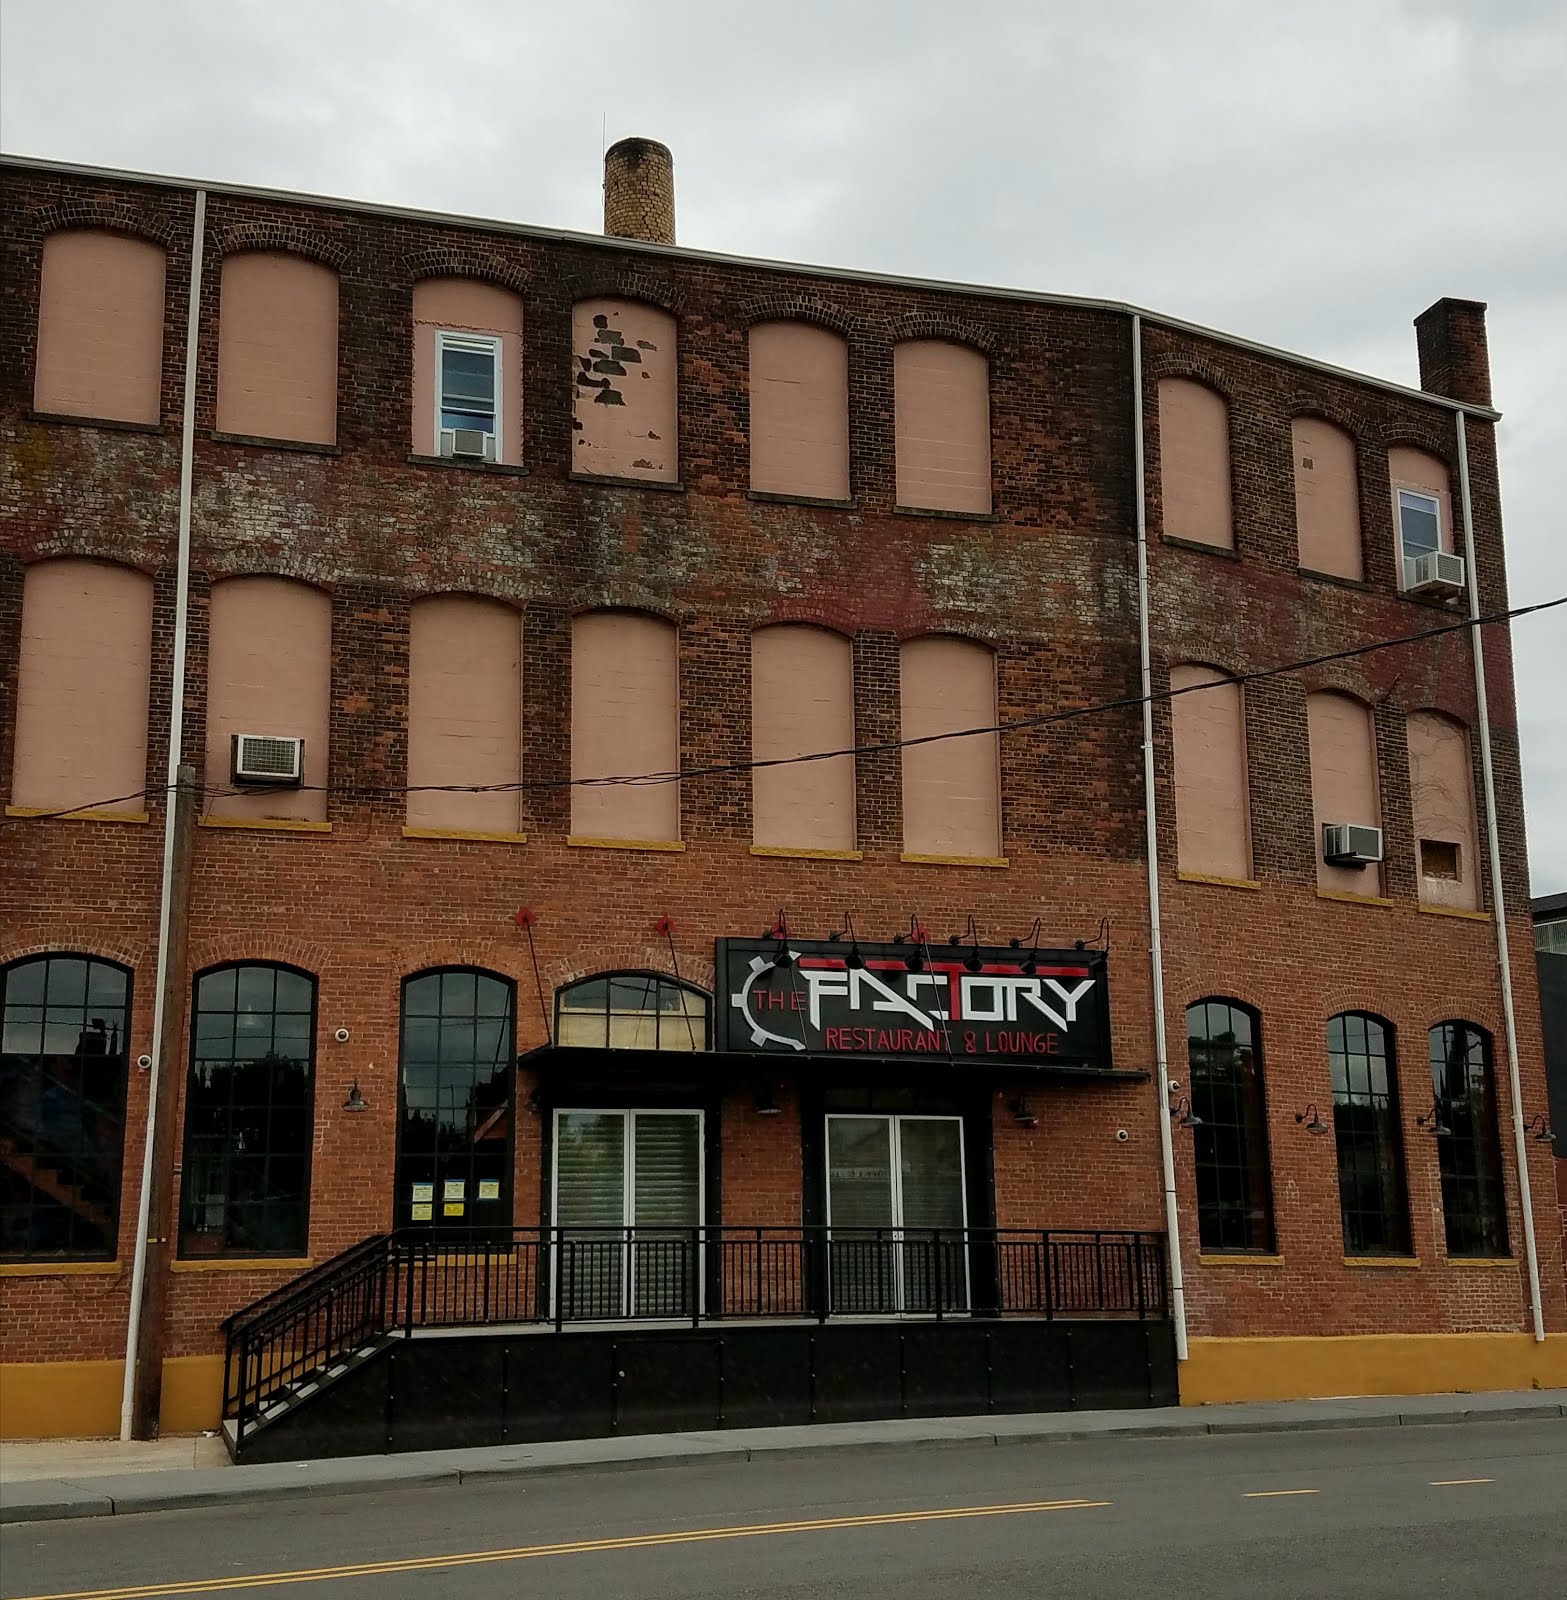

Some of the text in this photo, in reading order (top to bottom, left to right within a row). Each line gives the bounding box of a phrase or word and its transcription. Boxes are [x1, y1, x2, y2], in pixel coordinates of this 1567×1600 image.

[752, 957, 1097, 1033] THE FACTORY
[825, 1027, 1059, 1054] RESTAURANT & LOUNGE
